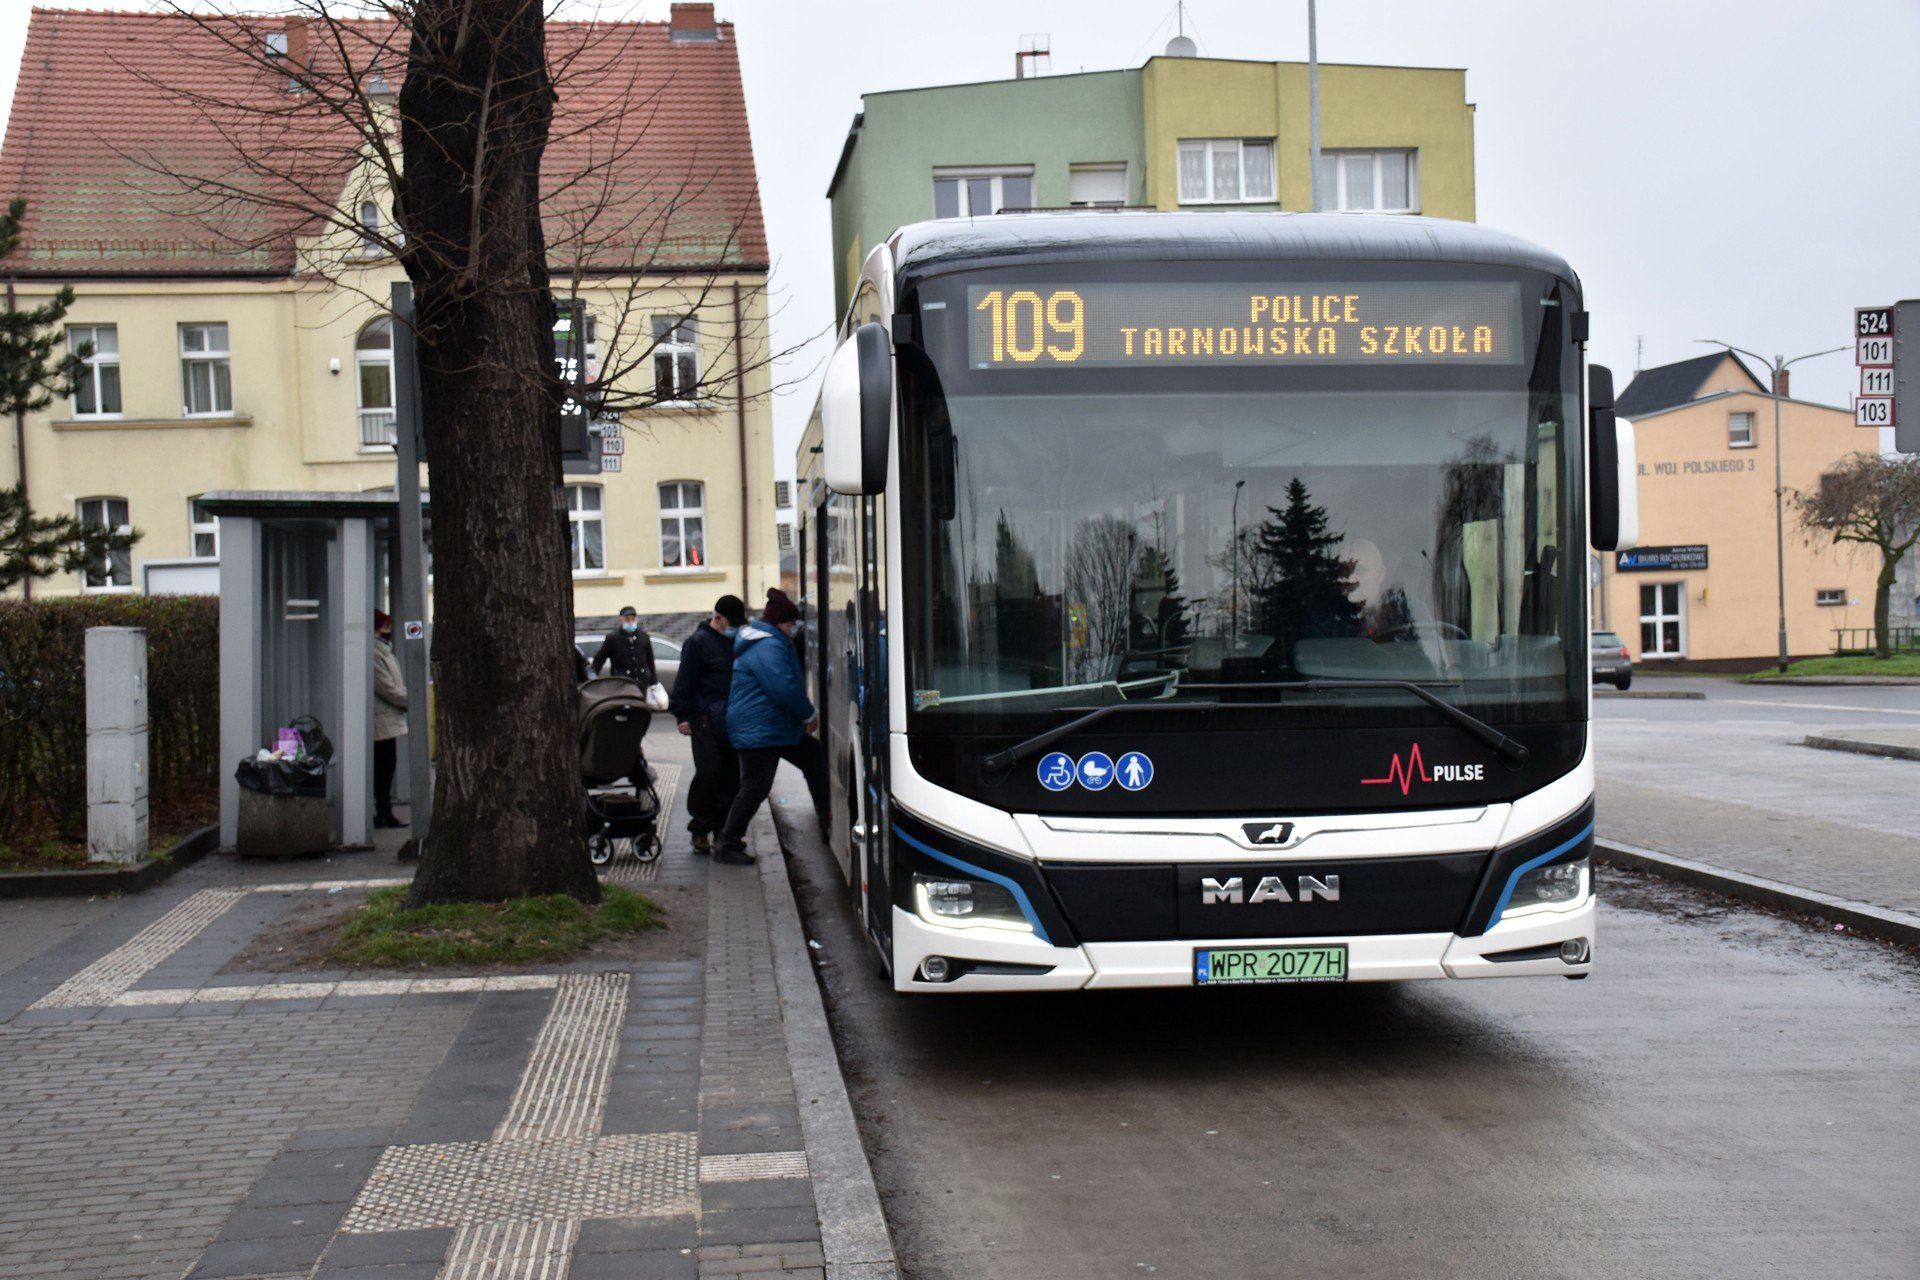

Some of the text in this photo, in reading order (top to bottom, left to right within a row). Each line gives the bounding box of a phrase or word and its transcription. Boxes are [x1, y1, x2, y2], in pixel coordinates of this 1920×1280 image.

[1250, 295, 1359, 323] POLICE
[976, 290, 1084, 362] 109
[1860, 312, 1888, 334] 524
[1120, 326, 1493, 356] TARNOWSKA SZKOŁA
[1863, 341, 1888, 361] 101
[1867, 372, 1891, 391] 111
[1860, 403, 1887, 422] 103
[606, 440, 621, 452] 110
[604, 458, 617, 470] 111
[1683, 460, 1744, 474] POLSKIEGO
[1748, 459, 1755, 471] 3
[1433, 764, 1484, 781] PULSE
[1202, 875, 1340, 904] MAN
[1211, 951, 1342, 977] WPR 2077H
